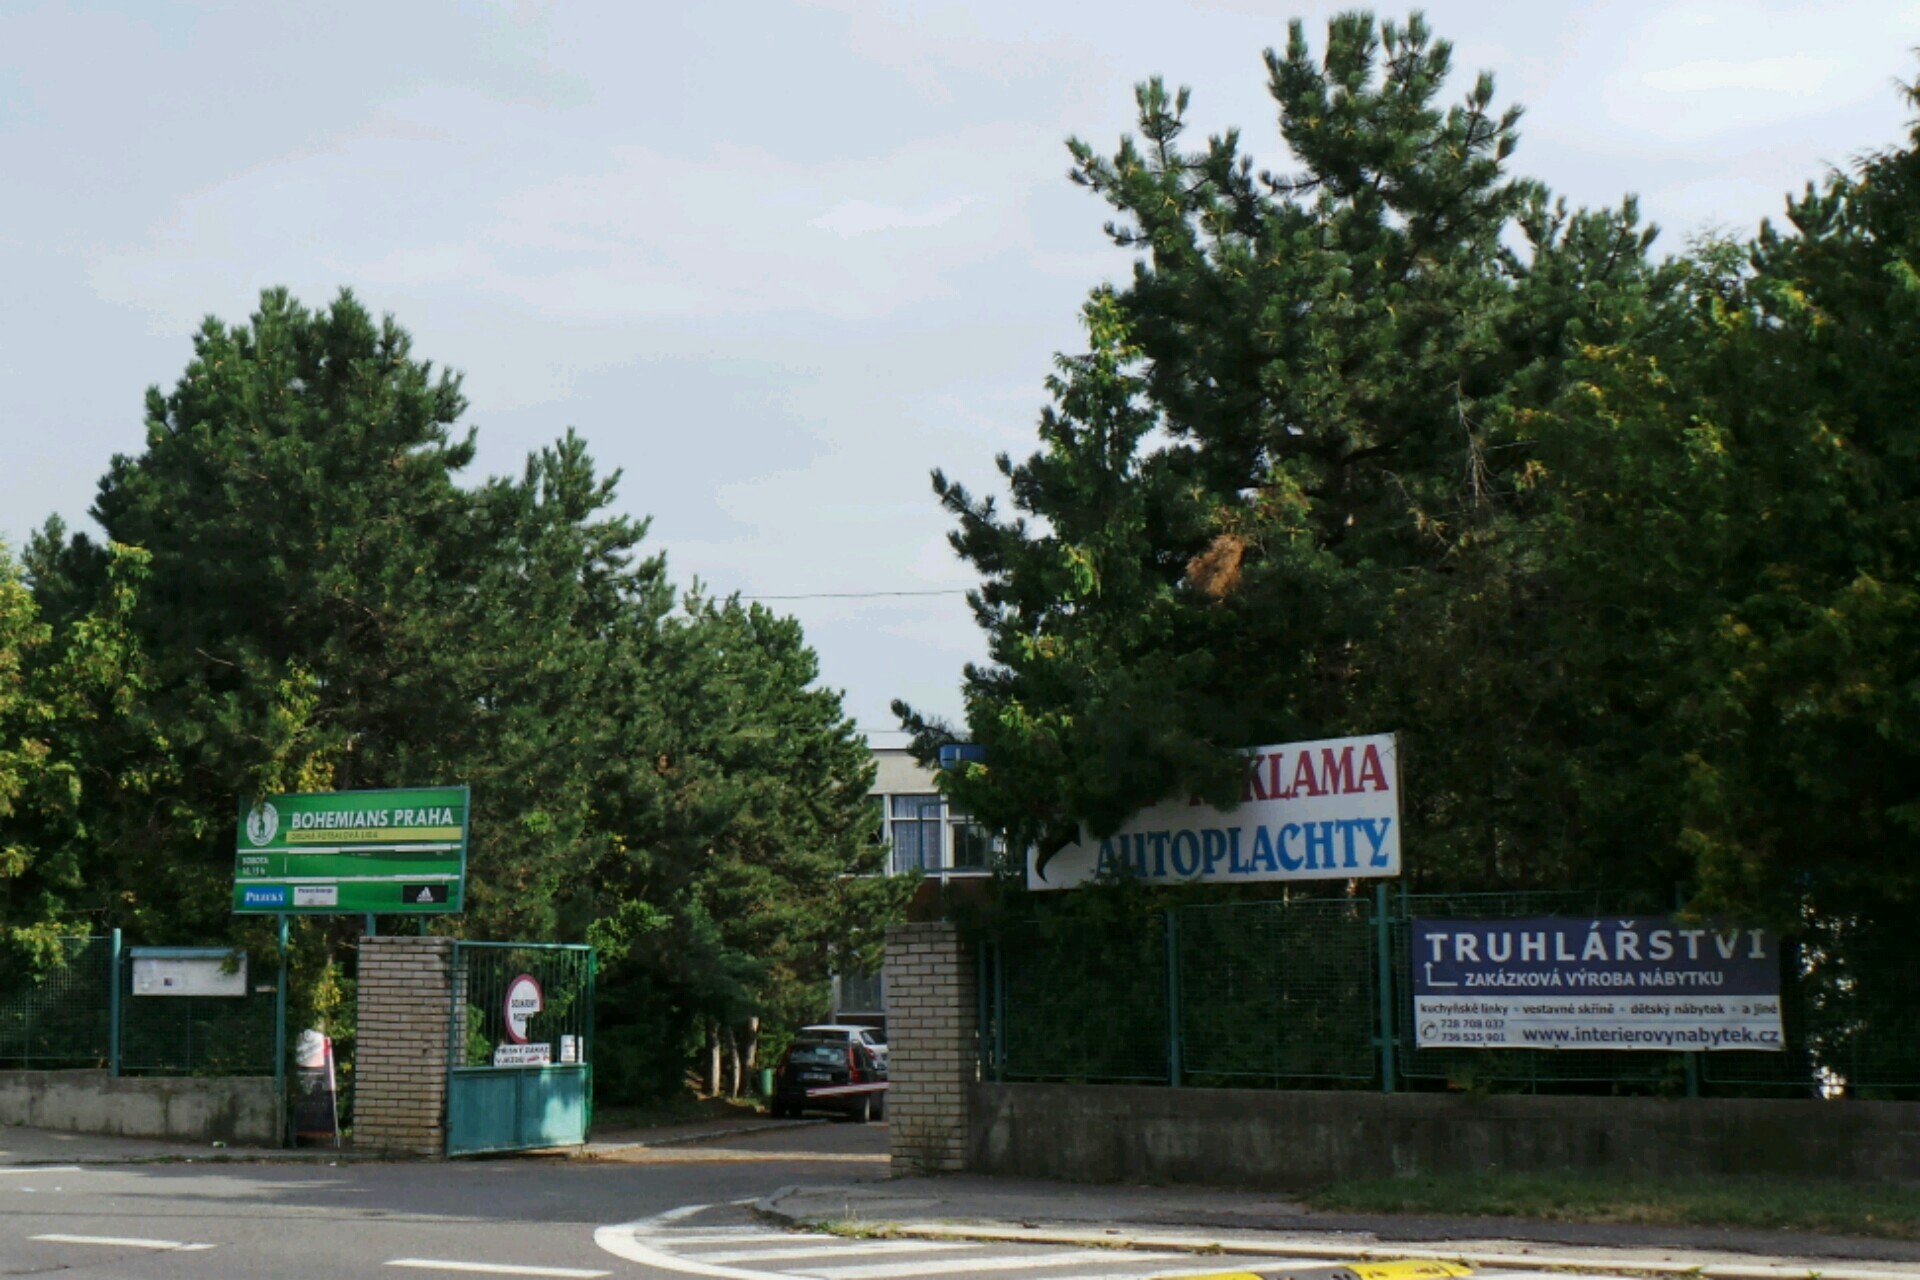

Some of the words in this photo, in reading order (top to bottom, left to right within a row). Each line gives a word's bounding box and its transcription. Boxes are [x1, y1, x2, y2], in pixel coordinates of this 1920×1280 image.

[1190, 744, 1389, 806] KLAMA
[291, 809, 389, 829] BOHEMIANS
[394, 807, 454, 826] PRAHA
[1095, 817, 1391, 877] AUTOPLACHTY
[1465, 967, 1562, 987] ZAKÁZKOVÁ
[1567, 967, 1635, 986] VÝROBA
[1640, 968, 1723, 986] NÁBYTKU
[1420, 1002, 1479, 1015] kuchyňské
[1481, 1002, 1508, 1015] linky
[1522, 1003, 1575, 1014] vestavné
[1631, 1003, 1670, 1016] dětský
[1675, 1003, 1725, 1016] nábytek
[1742, 1005, 1750, 1014] a
[1753, 1003, 1778, 1016] jiné
[1523, 1025, 1779, 1046] www.interierovynabytek.cz
